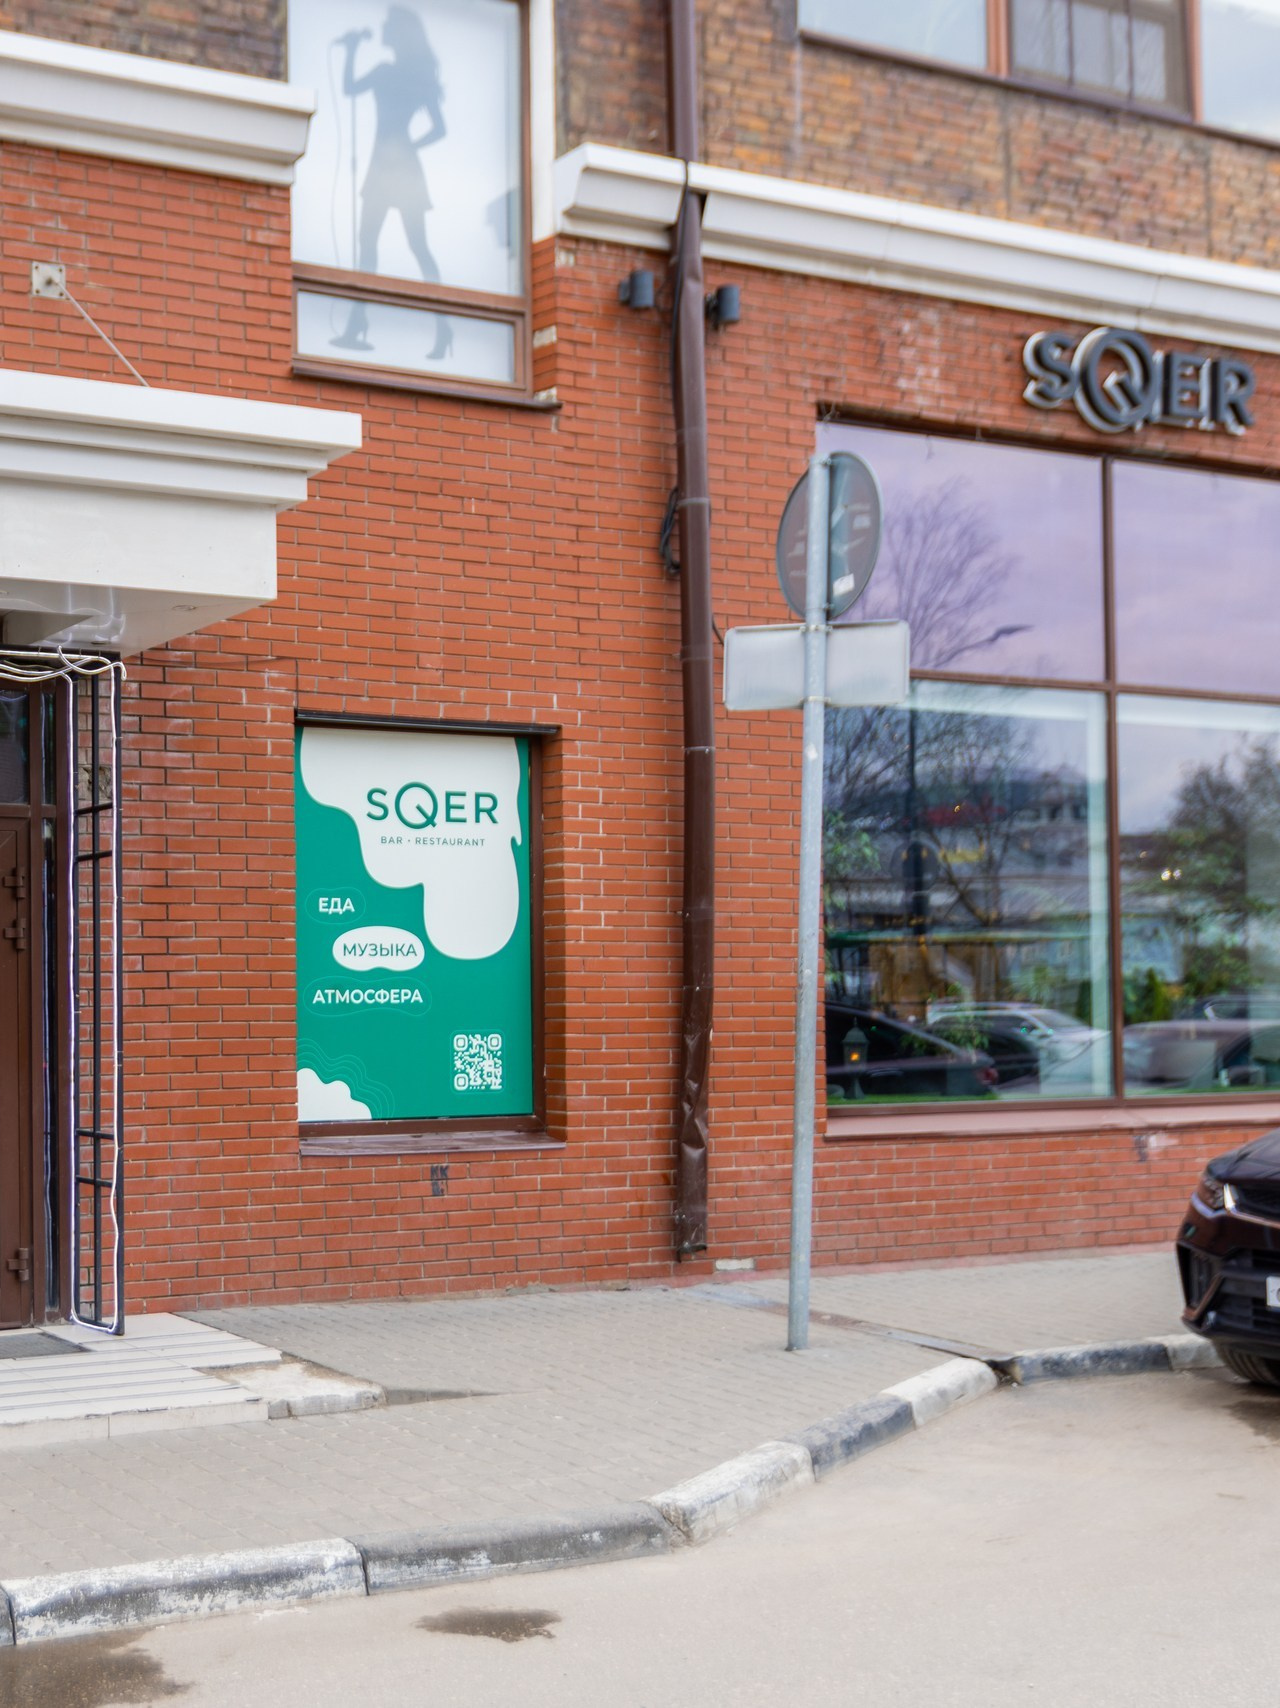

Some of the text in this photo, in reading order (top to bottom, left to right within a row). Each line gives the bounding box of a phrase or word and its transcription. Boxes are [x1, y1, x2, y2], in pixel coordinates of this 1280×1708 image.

[1023, 327, 1256, 437] SQER
[366, 781, 499, 829] SQER
[380, 835, 486, 847] BAR RESTAURANT
[318, 896, 356, 914] ЕДА
[342, 942, 418, 958] МУЗЫКА
[312, 988, 424, 1005] АТМОСФЕРА
